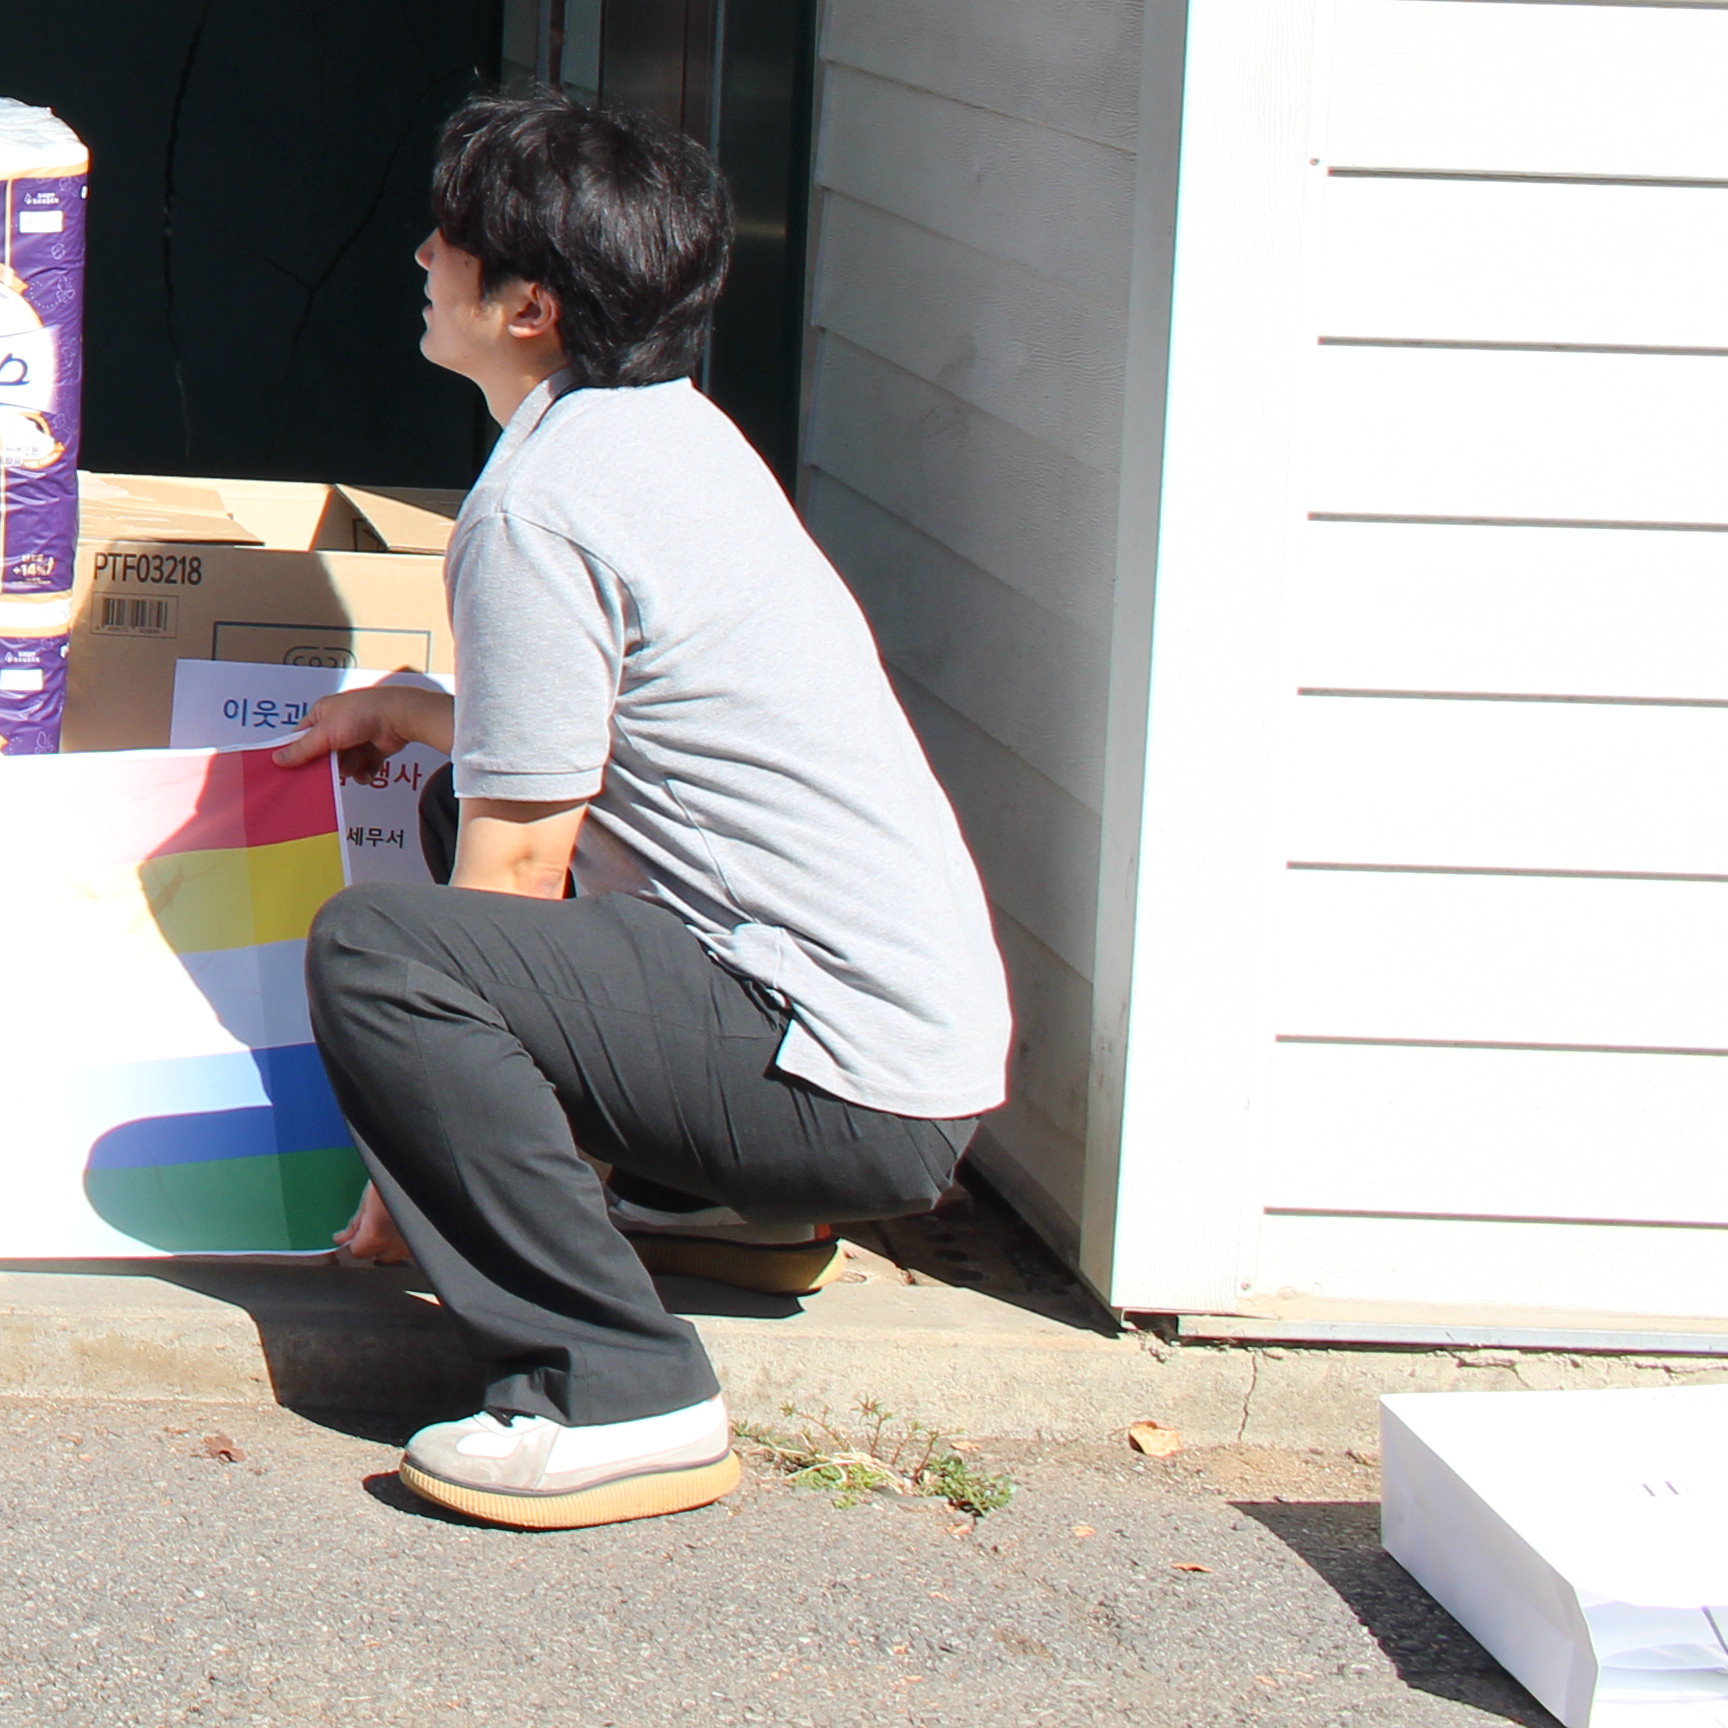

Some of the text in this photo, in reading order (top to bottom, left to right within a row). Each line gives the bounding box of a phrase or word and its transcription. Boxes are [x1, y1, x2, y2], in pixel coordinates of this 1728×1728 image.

[93, 551, 203, 585] PTF03218
[222, 696, 310, 727] 이웃과
[347, 826, 405, 850] 세무서
